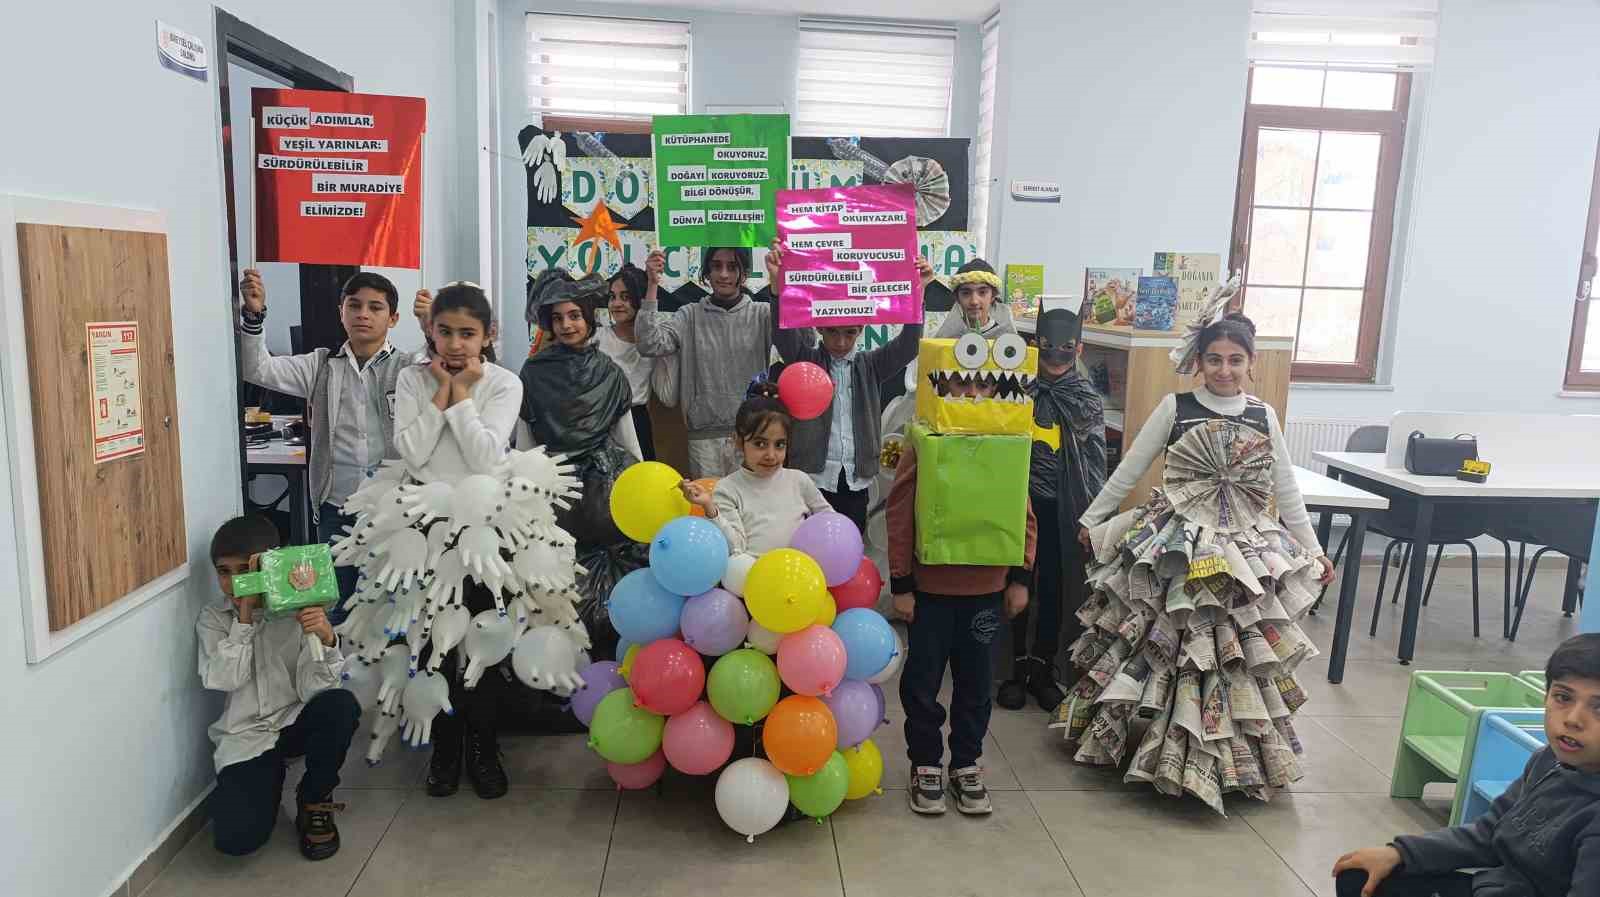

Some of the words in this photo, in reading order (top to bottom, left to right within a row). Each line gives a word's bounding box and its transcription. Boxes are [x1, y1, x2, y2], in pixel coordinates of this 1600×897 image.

[267, 115, 307, 127] KÜÇÜK
[315, 115, 374, 127] ADIMLAR,
[665, 135, 729, 144] KÜTÜPHANEDE
[284, 139, 314, 151] YEŞİL
[319, 140, 381, 150] YARINLAR:
[717, 151, 768, 159] OKUYORUZ,
[263, 157, 364, 171] SÜRDÜRÜLEBİLİR
[671, 170, 704, 180] DOĞAYI
[317, 181, 336, 193] BİR
[340, 181, 402, 193] MURADİYE
[684, 188, 706, 197] BİLGİ
[709, 186, 754, 197] DÖNÜŞÜR,
[305, 204, 363, 216] ELİMİZDE!
[815, 204, 843, 213] KİTAP
[673, 215, 704, 225] DÜNYA
[712, 212, 764, 222] GÜZELLEŞİR!
[837, 252, 904, 260] KORUYUCUSU:
[852, 285, 868, 294] BİR
[870, 284, 910, 293] GELECEK
[815, 306, 873, 316] YAZIYORUZ!
